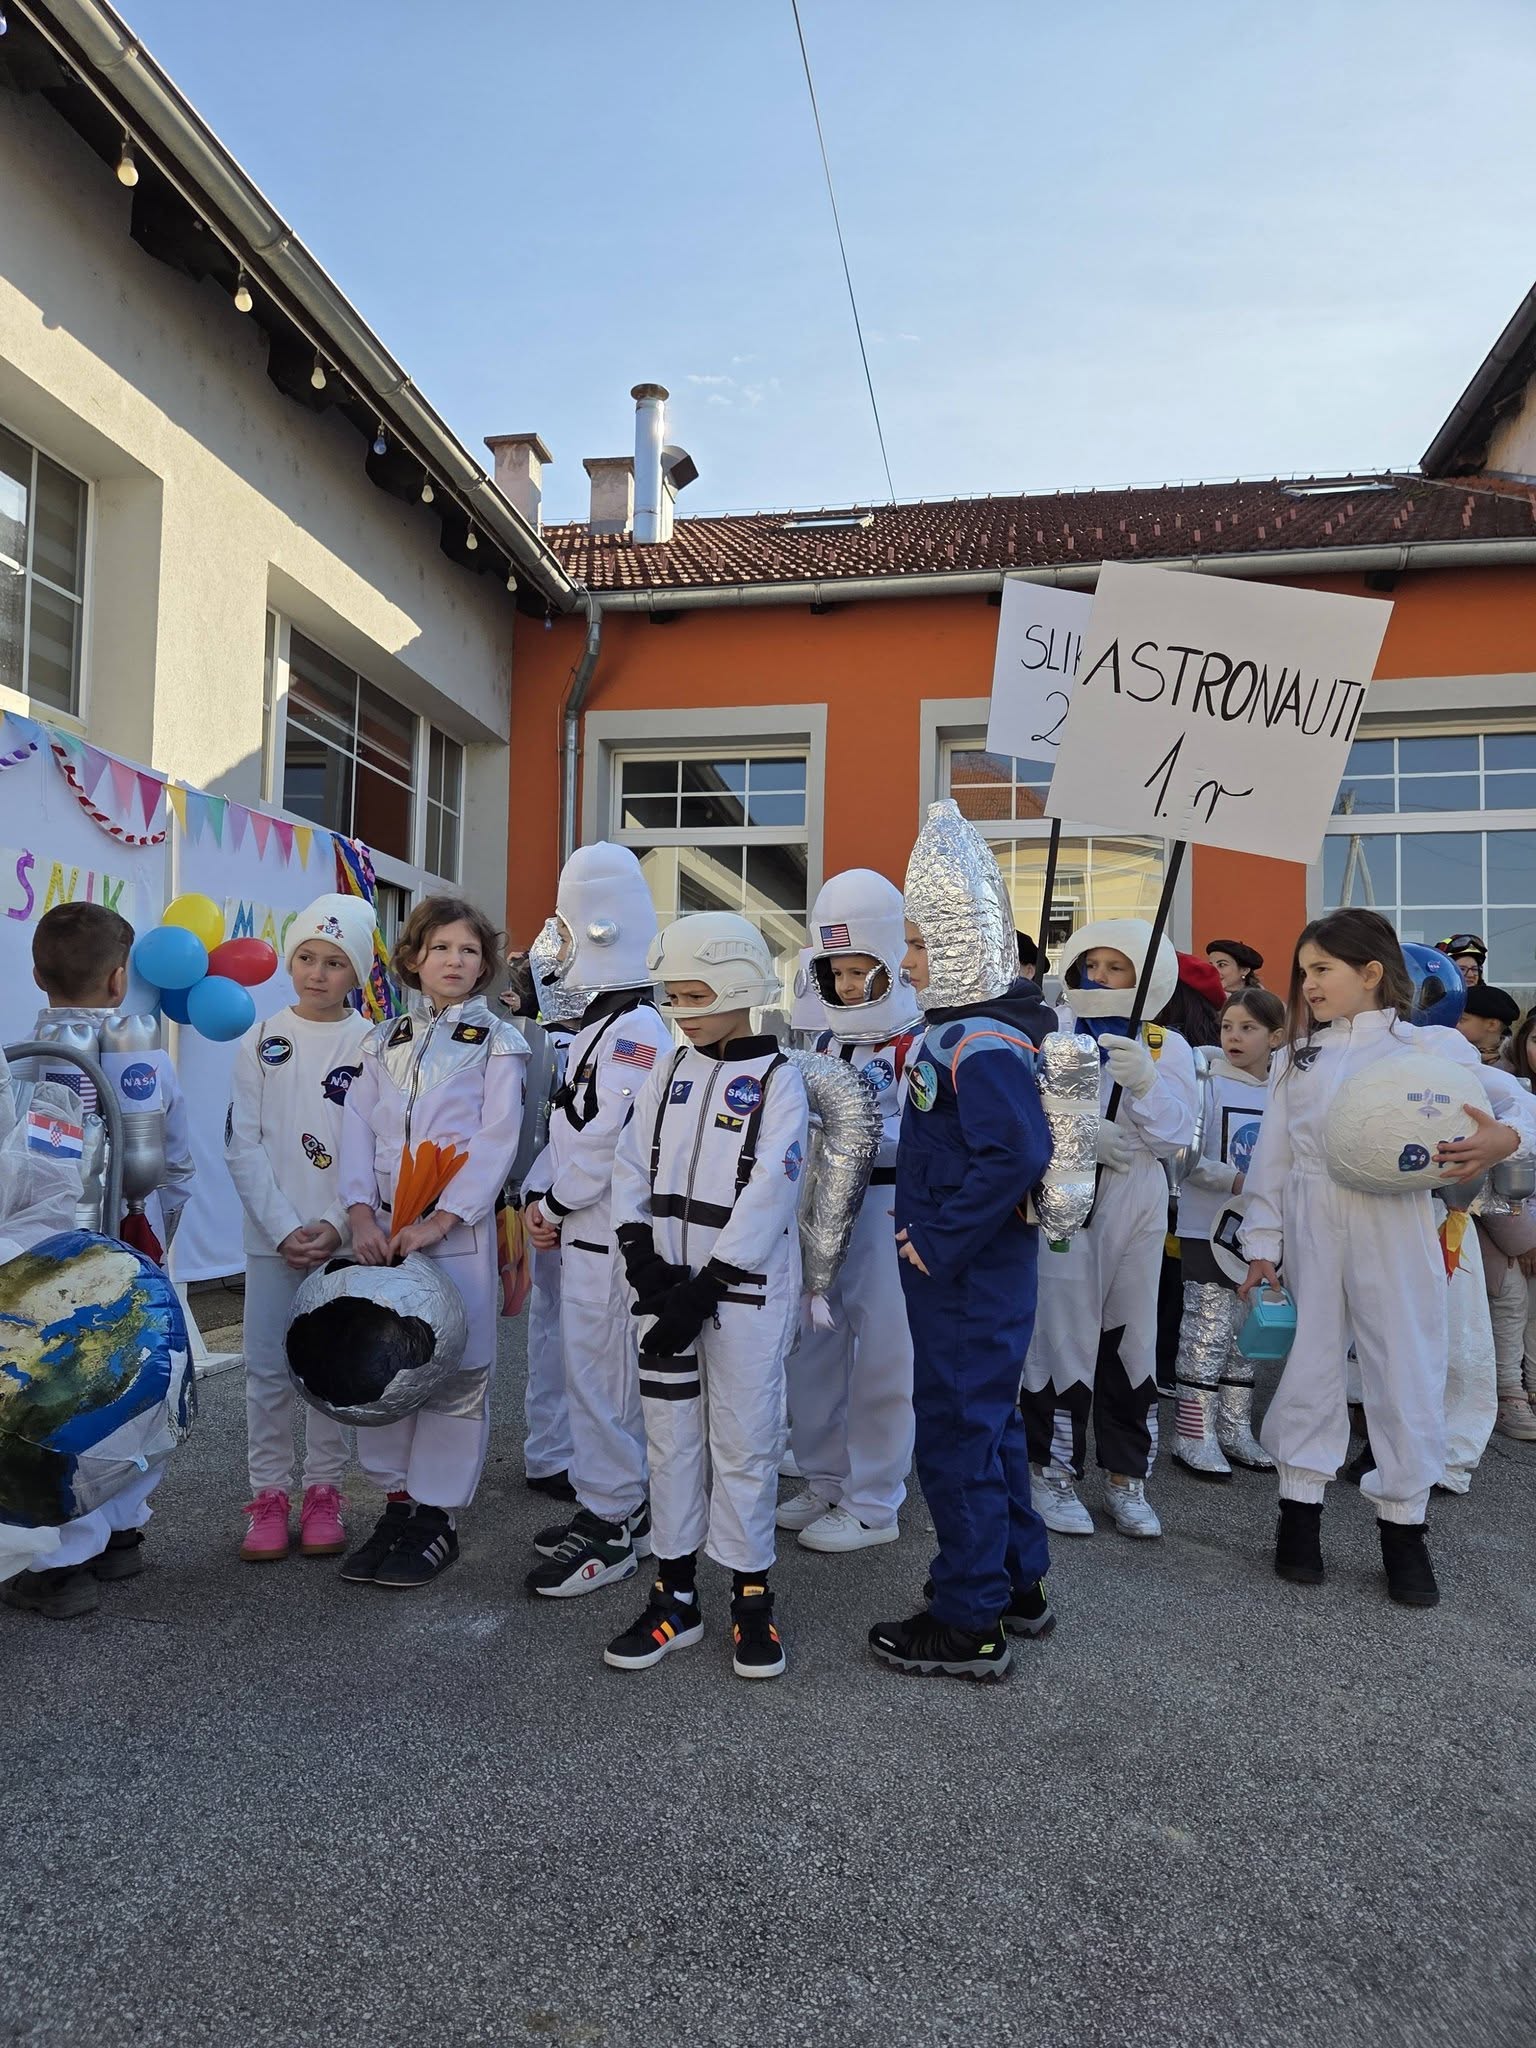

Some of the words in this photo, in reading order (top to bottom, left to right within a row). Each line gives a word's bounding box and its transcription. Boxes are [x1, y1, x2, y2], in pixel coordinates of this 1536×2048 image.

[1082, 637, 1366, 742] ASTRONAUTI
[1144, 731, 1187, 818] 1.
[123, 1076, 156, 1087] NASA
[727, 1088, 761, 1103] SPACE
